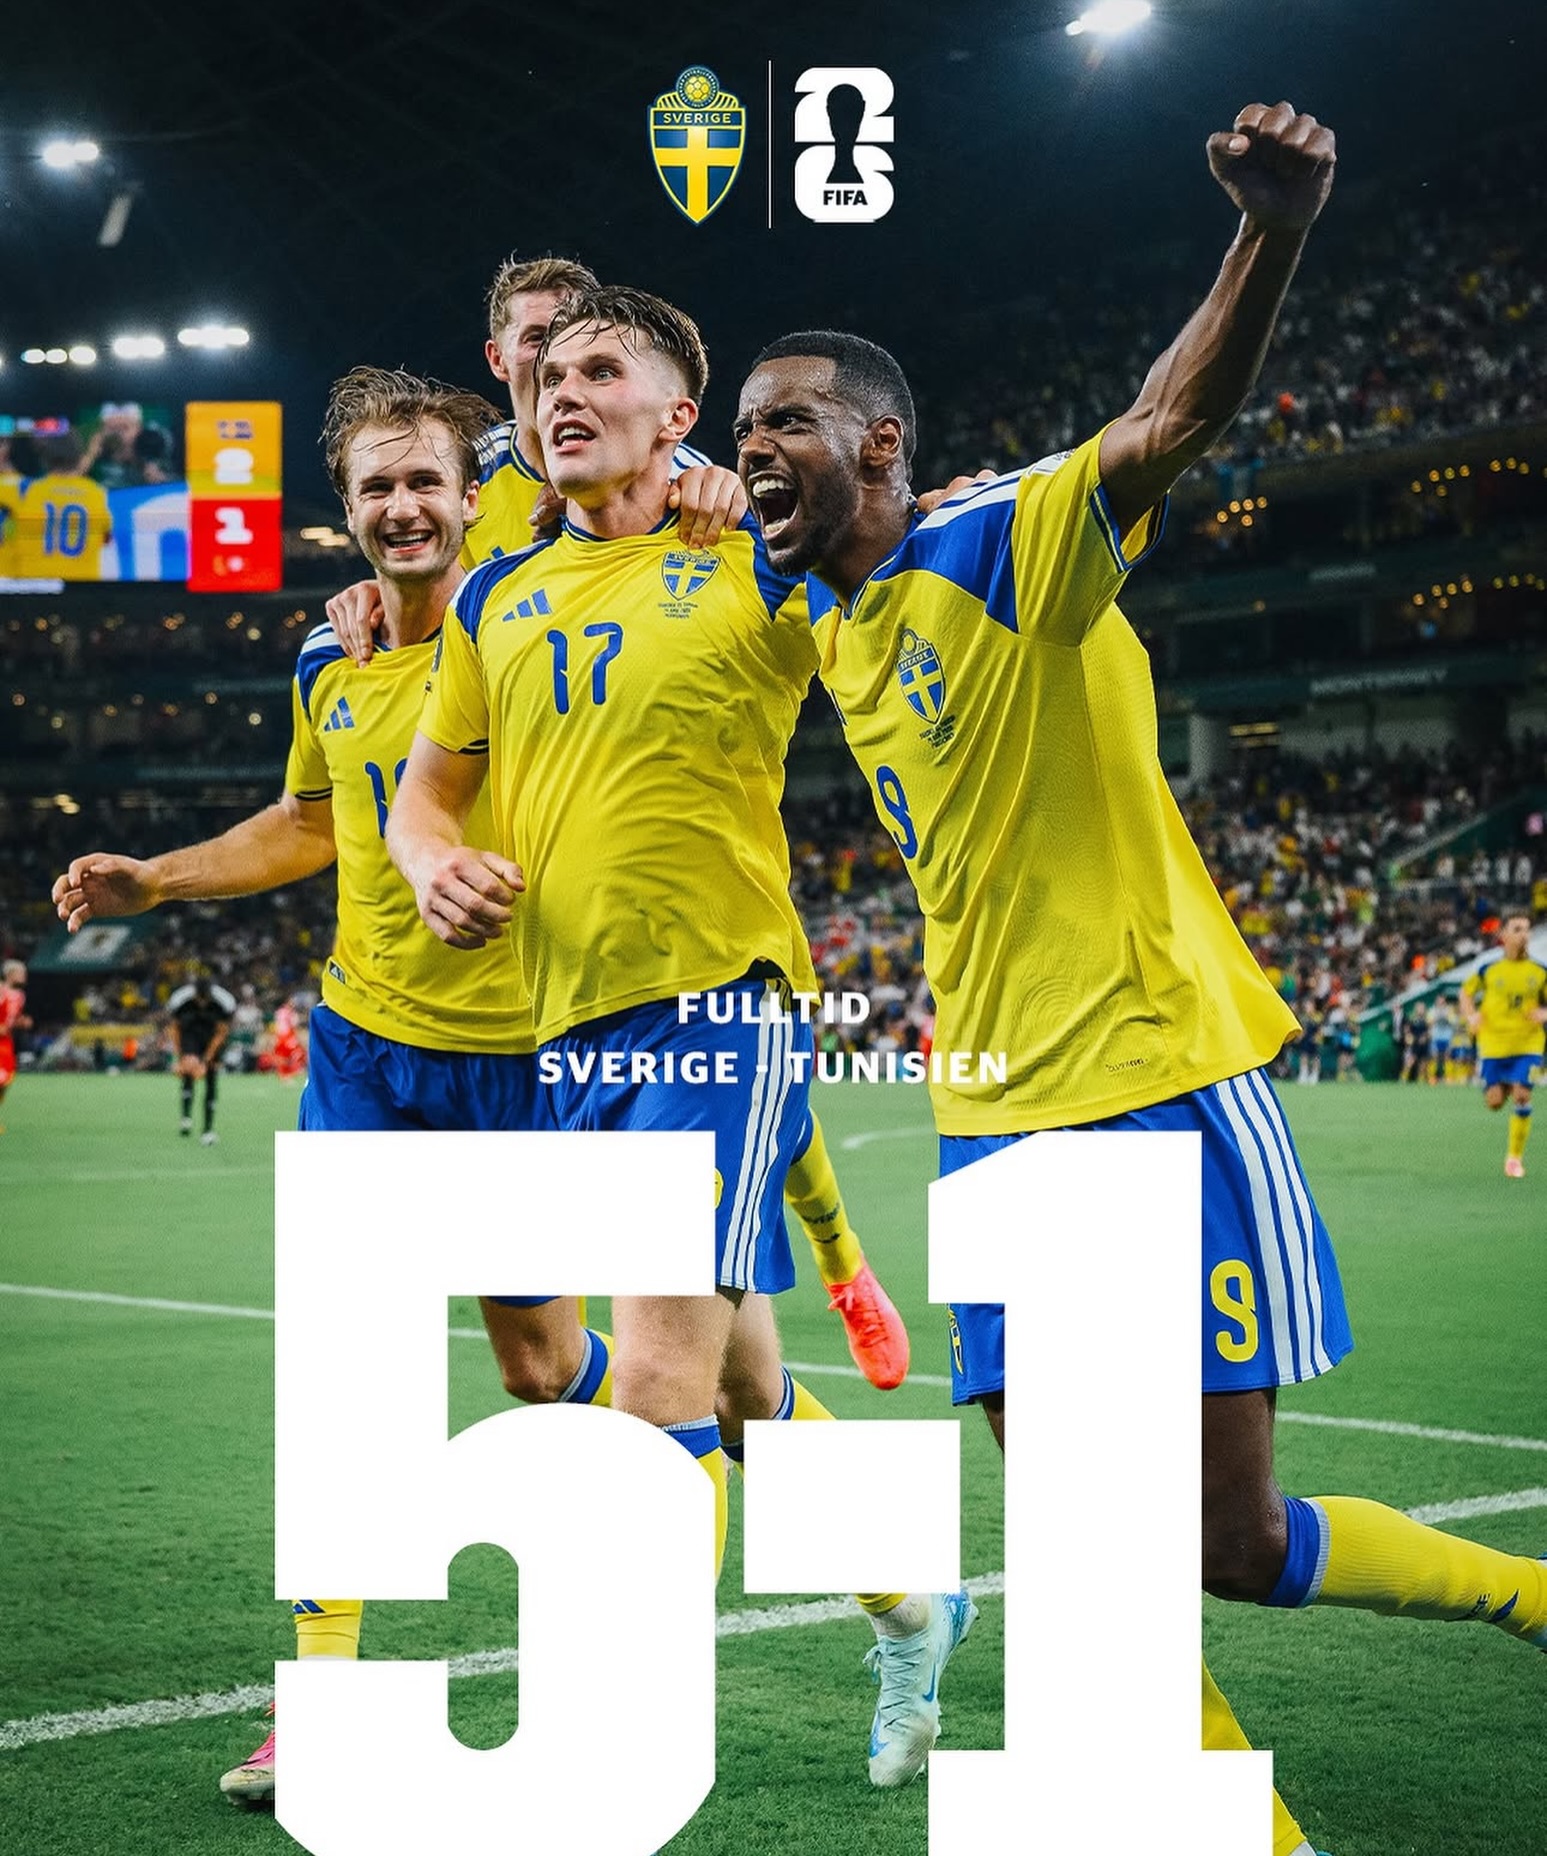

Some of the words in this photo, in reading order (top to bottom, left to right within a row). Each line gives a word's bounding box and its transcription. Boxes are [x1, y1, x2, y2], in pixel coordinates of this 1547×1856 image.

[43, 502, 89, 557] 10
[214, 507, 254, 545] 1
[547, 622, 623, 715] 17
[876, 765, 918, 860] 9
[1210, 1259, 1258, 1363] 9
